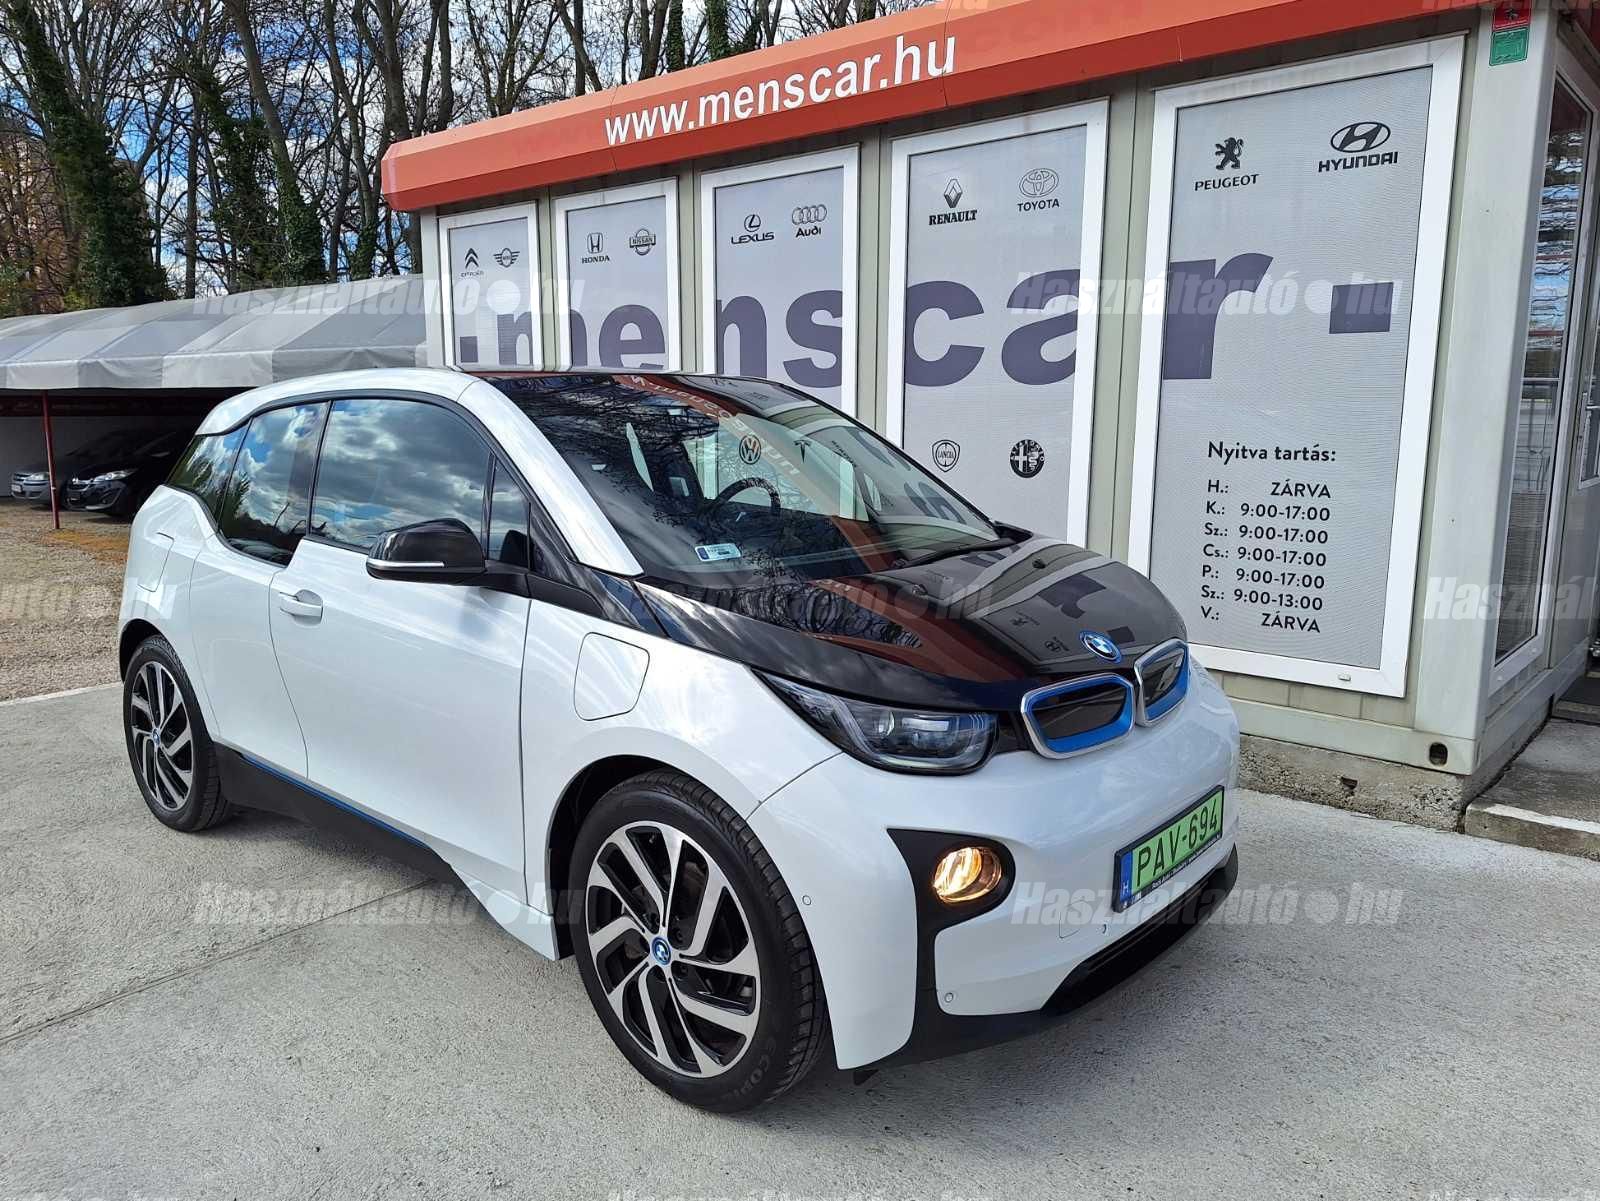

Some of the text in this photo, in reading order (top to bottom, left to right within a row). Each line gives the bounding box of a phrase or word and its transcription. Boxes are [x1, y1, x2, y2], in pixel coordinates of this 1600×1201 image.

[604, 35, 956, 146] www.menscar.hu
[1317, 151, 1399, 173] HYUNDAI
[1194, 173, 1260, 191] PEUGEOT
[1017, 198, 1060, 212] TOYOTA
[928, 209, 978, 226] RENAULT
[730, 231, 775, 245] LEXUS
[795, 226, 822, 238] Audi
[581, 255, 610, 264] HONDA
[1207, 441, 1337, 465] Nyitva tartás:
[1207, 478, 1331, 498] H.: ZÁRVA
[1206, 501, 1330, 521] K.: 9:00-17:00
[1204, 522, 1328, 544] Sz.: 9:00-17:00
[1203, 544, 1327, 567] Cs.: 9:00-17:00
[1202, 564, 1325, 589] P.: 9:00-17:00
[1201, 584, 1323, 611] Sz.: 9:00-13:00
[1200, 605, 1321, 633] V.: ZÁRVA
[1136, 797, 1218, 887] PAV-694
